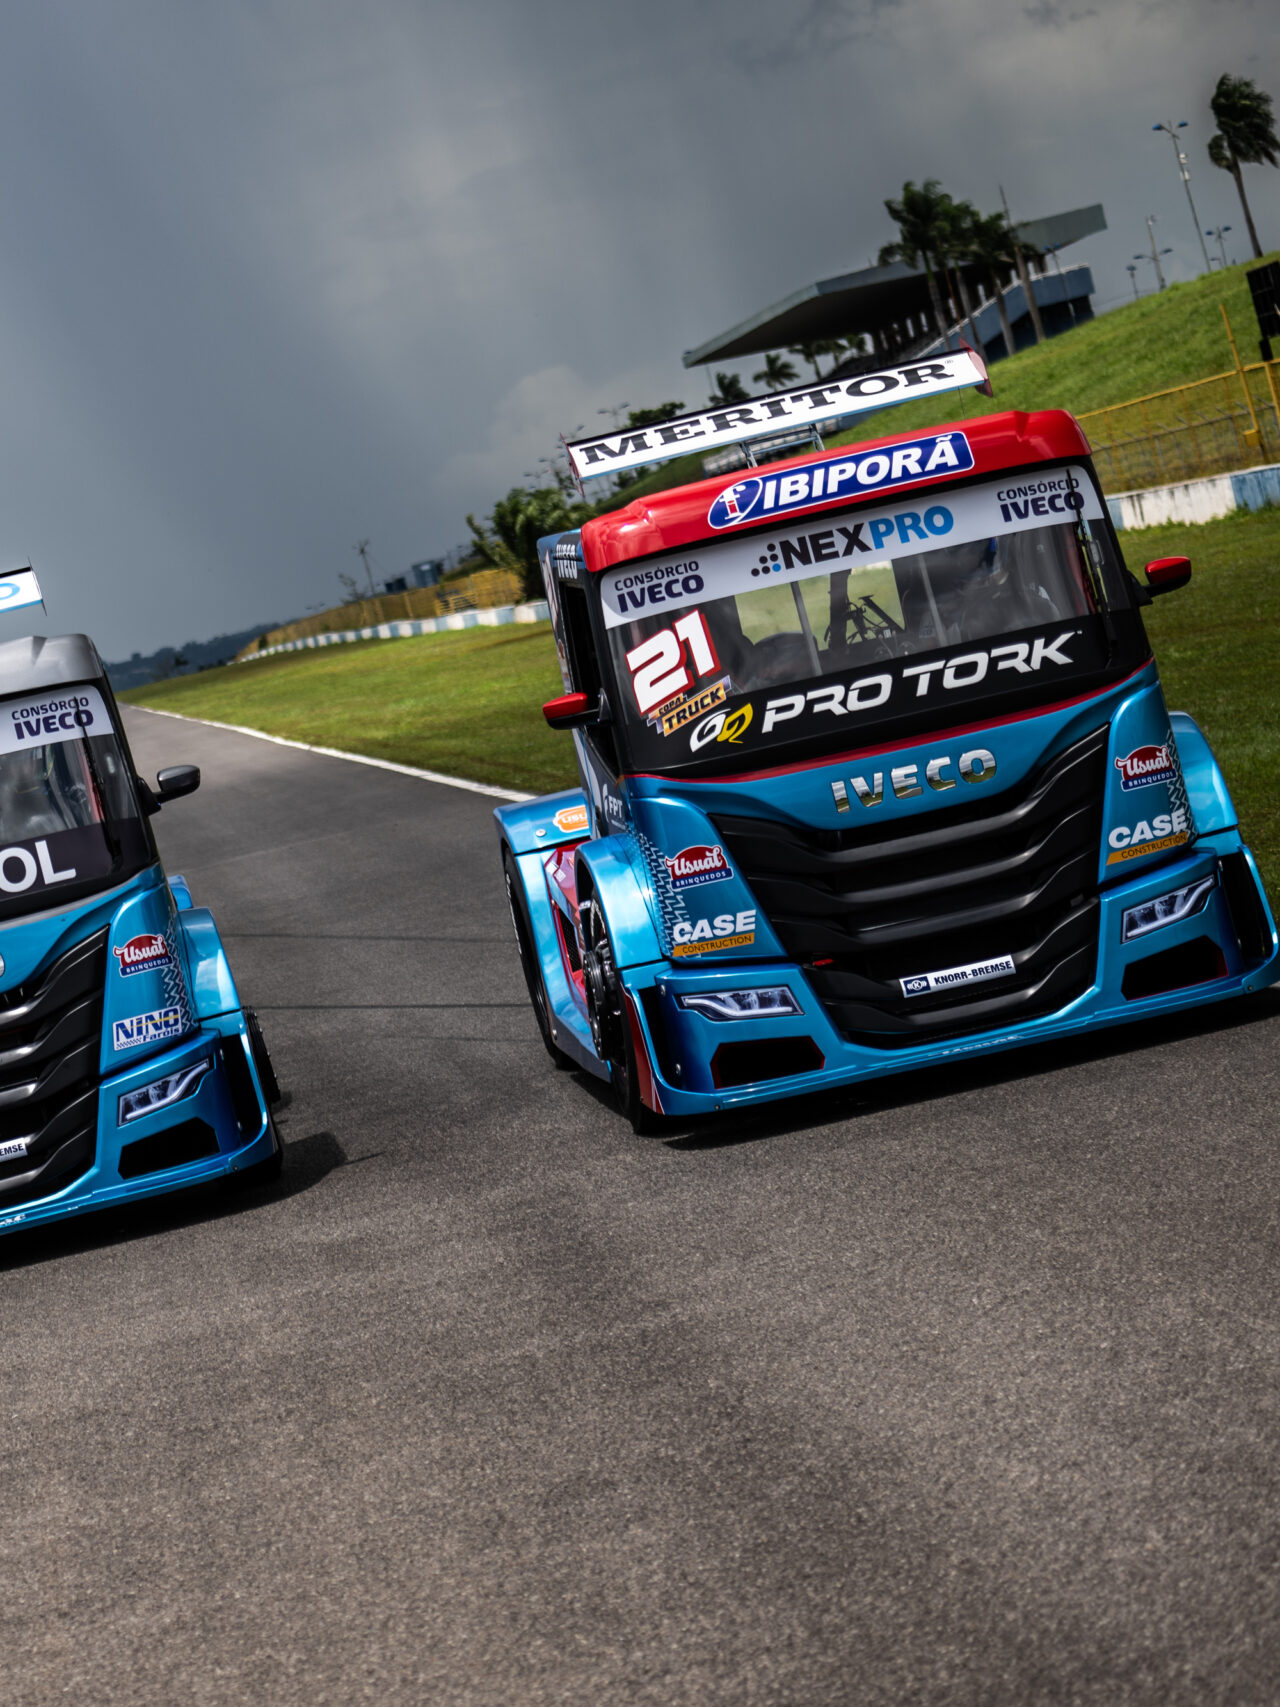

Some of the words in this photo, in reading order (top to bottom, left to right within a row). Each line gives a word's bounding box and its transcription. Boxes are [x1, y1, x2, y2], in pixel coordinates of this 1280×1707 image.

[763, 435, 960, 510] IBIPORÃ
[997, 478, 1080, 502] CONSÓRCIO
[1000, 491, 1085, 523] IVECO
[779, 505, 954, 570] NEXPRO
[614, 560, 700, 592] CONSÓRCIO
[617, 574, 705, 613] IVECO
[625, 608, 721, 717] 21
[761, 674, 893, 734] PRO
[902, 631, 1077, 697] TORK
[11, 696, 89, 721] CONSÓRCIO
[14, 708, 94, 740] IVECO
[664, 686, 723, 731] TRUCK
[1117, 747, 1170, 776] Usual
[831, 749, 997, 814] IVECO
[1128, 771, 1174, 787] BRINQUEDOS
[1108, 807, 1188, 849] CASE
[666, 846, 723, 876] Usual
[1121, 834, 1187, 860] CONSTRUCTION
[676, 871, 727, 887] BRINQUEDOS
[673, 909, 757, 944] CASE
[116, 936, 166, 963] Usual
[682, 935, 752, 954] CONSTRUCTION
[126, 959, 169, 973] BRINQUEDOS
[934, 960, 1013, 986] KNORR-BREMSE
